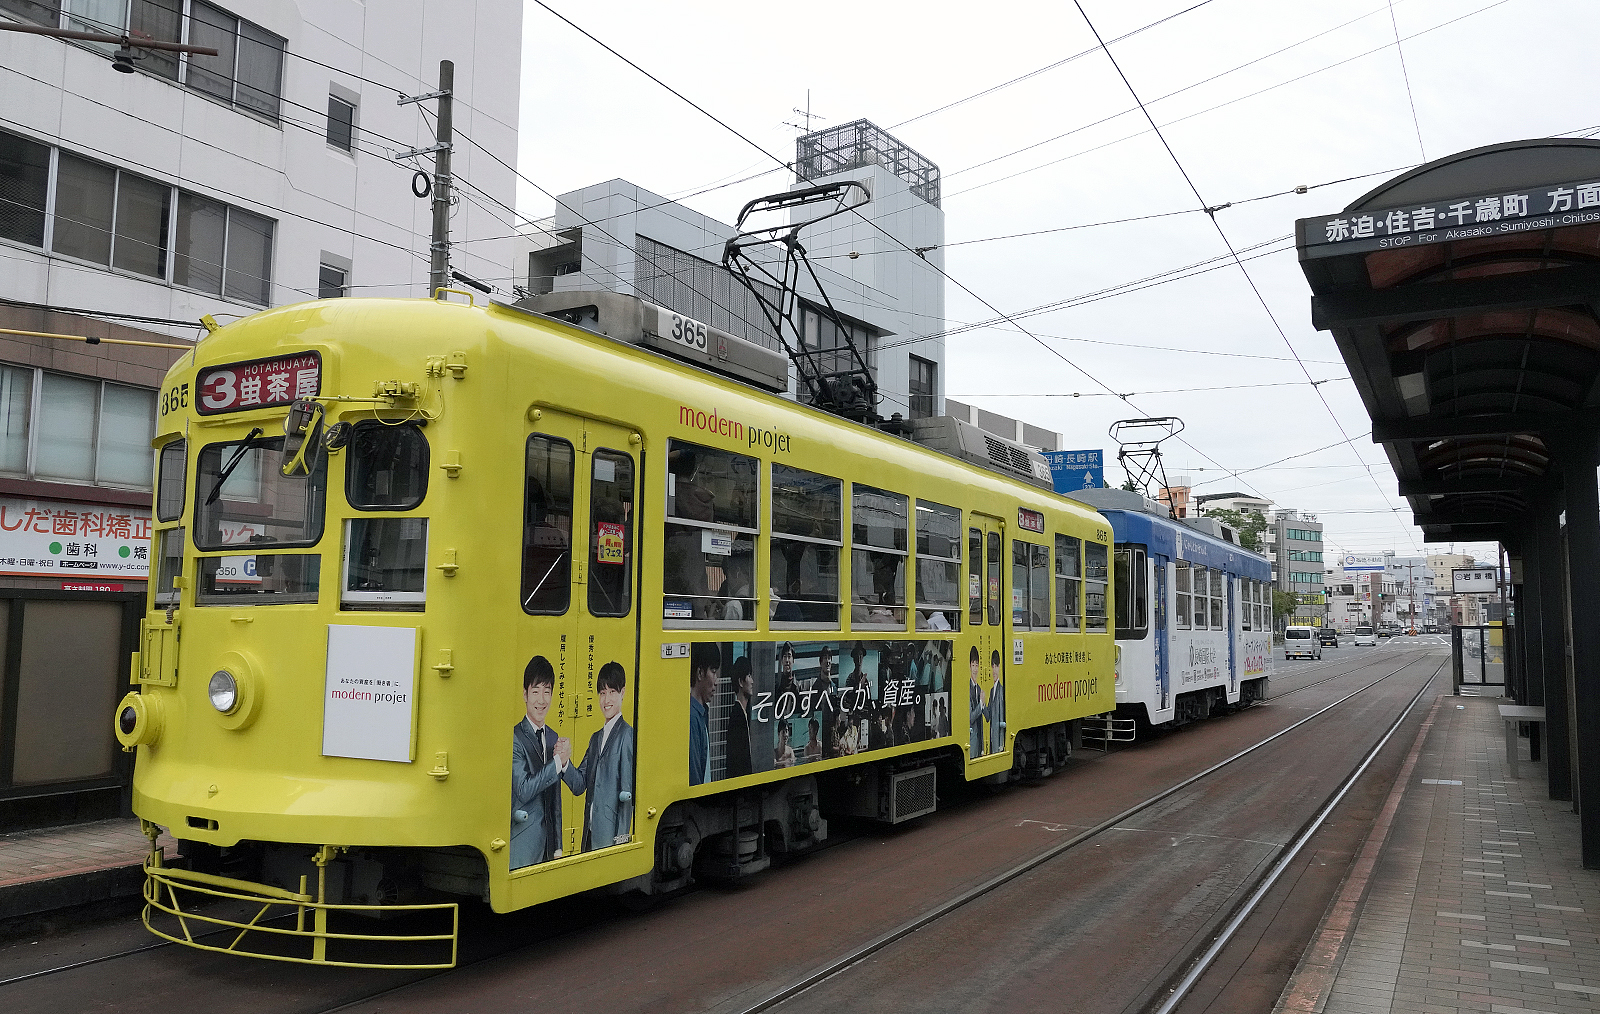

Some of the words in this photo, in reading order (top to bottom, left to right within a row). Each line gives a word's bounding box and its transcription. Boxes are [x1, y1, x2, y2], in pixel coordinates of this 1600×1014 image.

[1379, 236, 1412, 248] STOP
[1418, 232, 1438, 242] For
[671, 313, 707, 349] 365
[244, 356, 315, 376] HOTARUJAYA
[202, 370, 237, 409] 3
[679, 405, 743, 440] modern
[748, 425, 791, 454] projet
[0, 505, 152, 540] しだ歯科矯正
[66, 542, 98, 558] 歯科
[331, 688, 372, 701] modern
[374, 690, 407, 705] projet
[751, 678, 921, 723] そのすべてが、資産。
[1038, 673, 1072, 703] modern
[1074, 671, 1098, 703] projet
